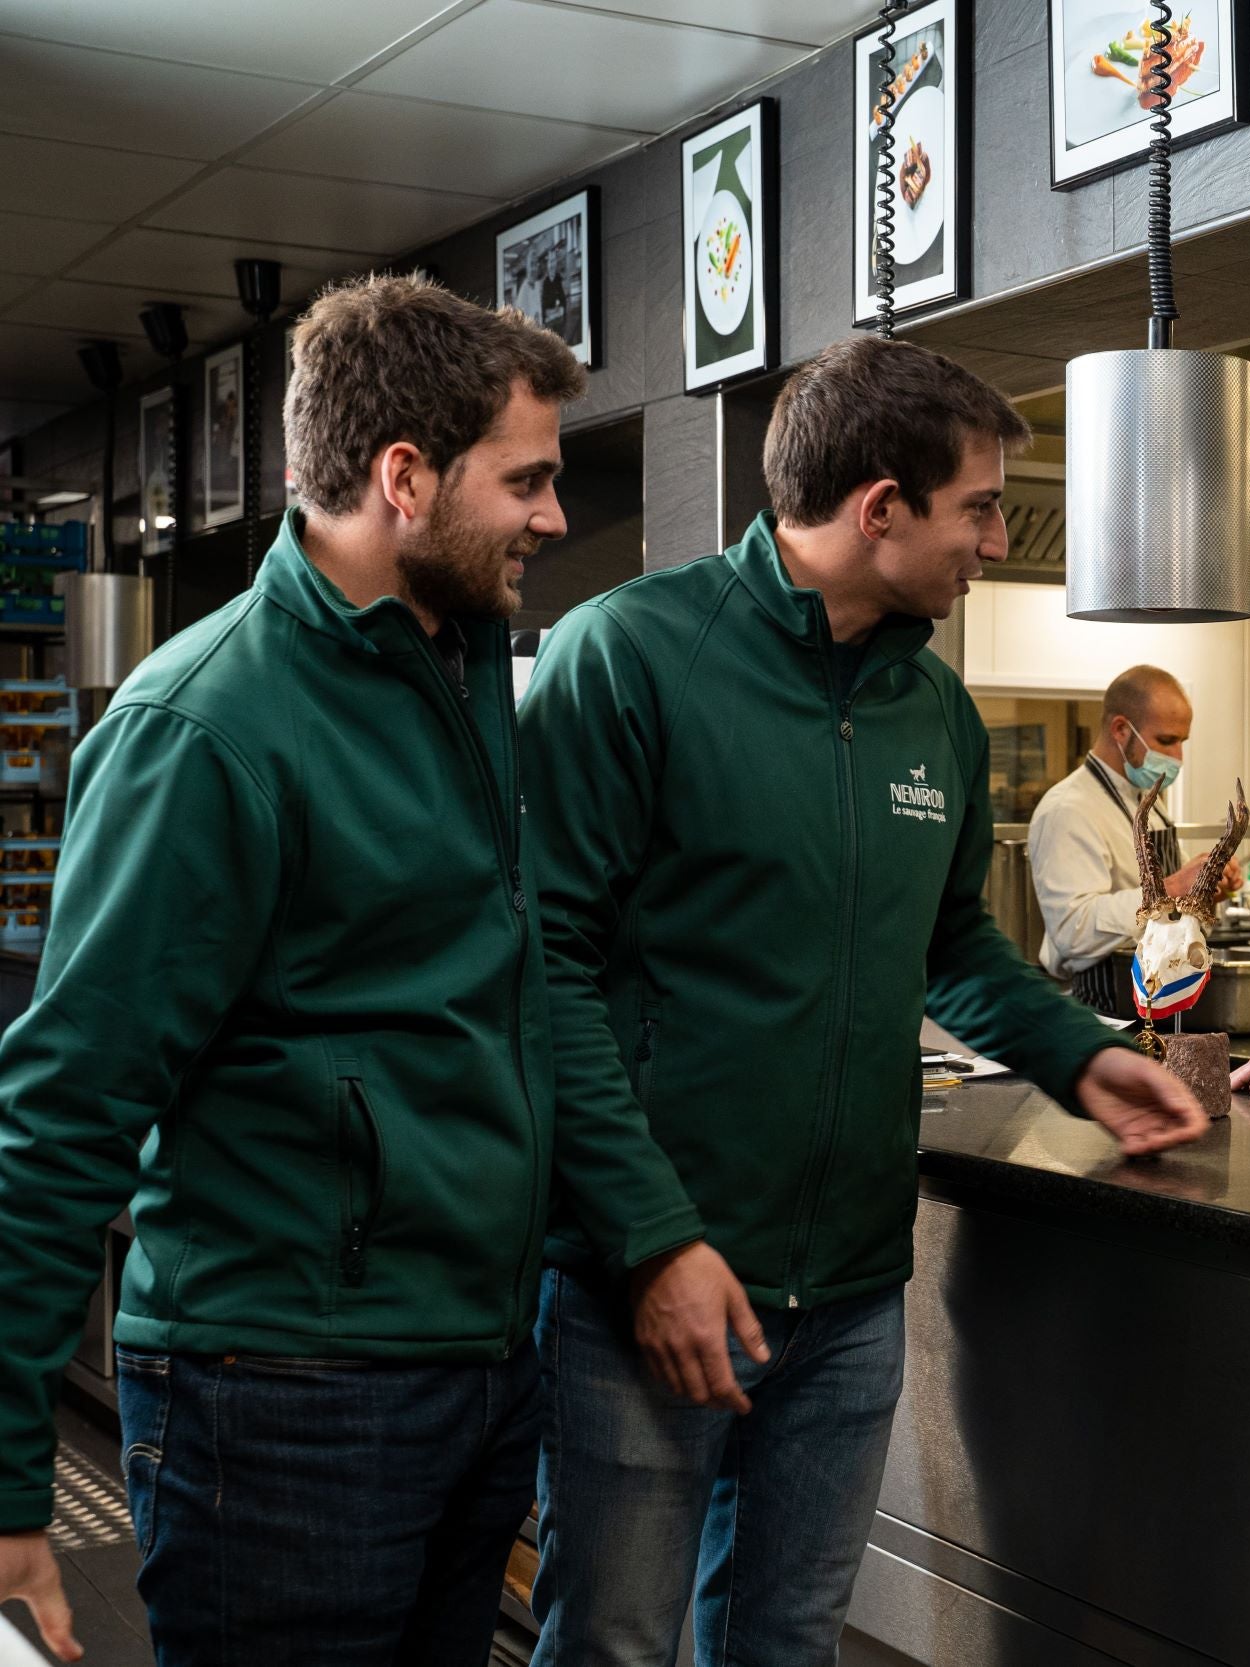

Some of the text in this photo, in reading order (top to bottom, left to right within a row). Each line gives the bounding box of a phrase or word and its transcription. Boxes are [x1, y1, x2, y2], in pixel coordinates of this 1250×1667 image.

[890, 783, 945, 809] NEMROD
[892, 803, 902, 815] Le
[902, 807, 927, 821] sauvage
